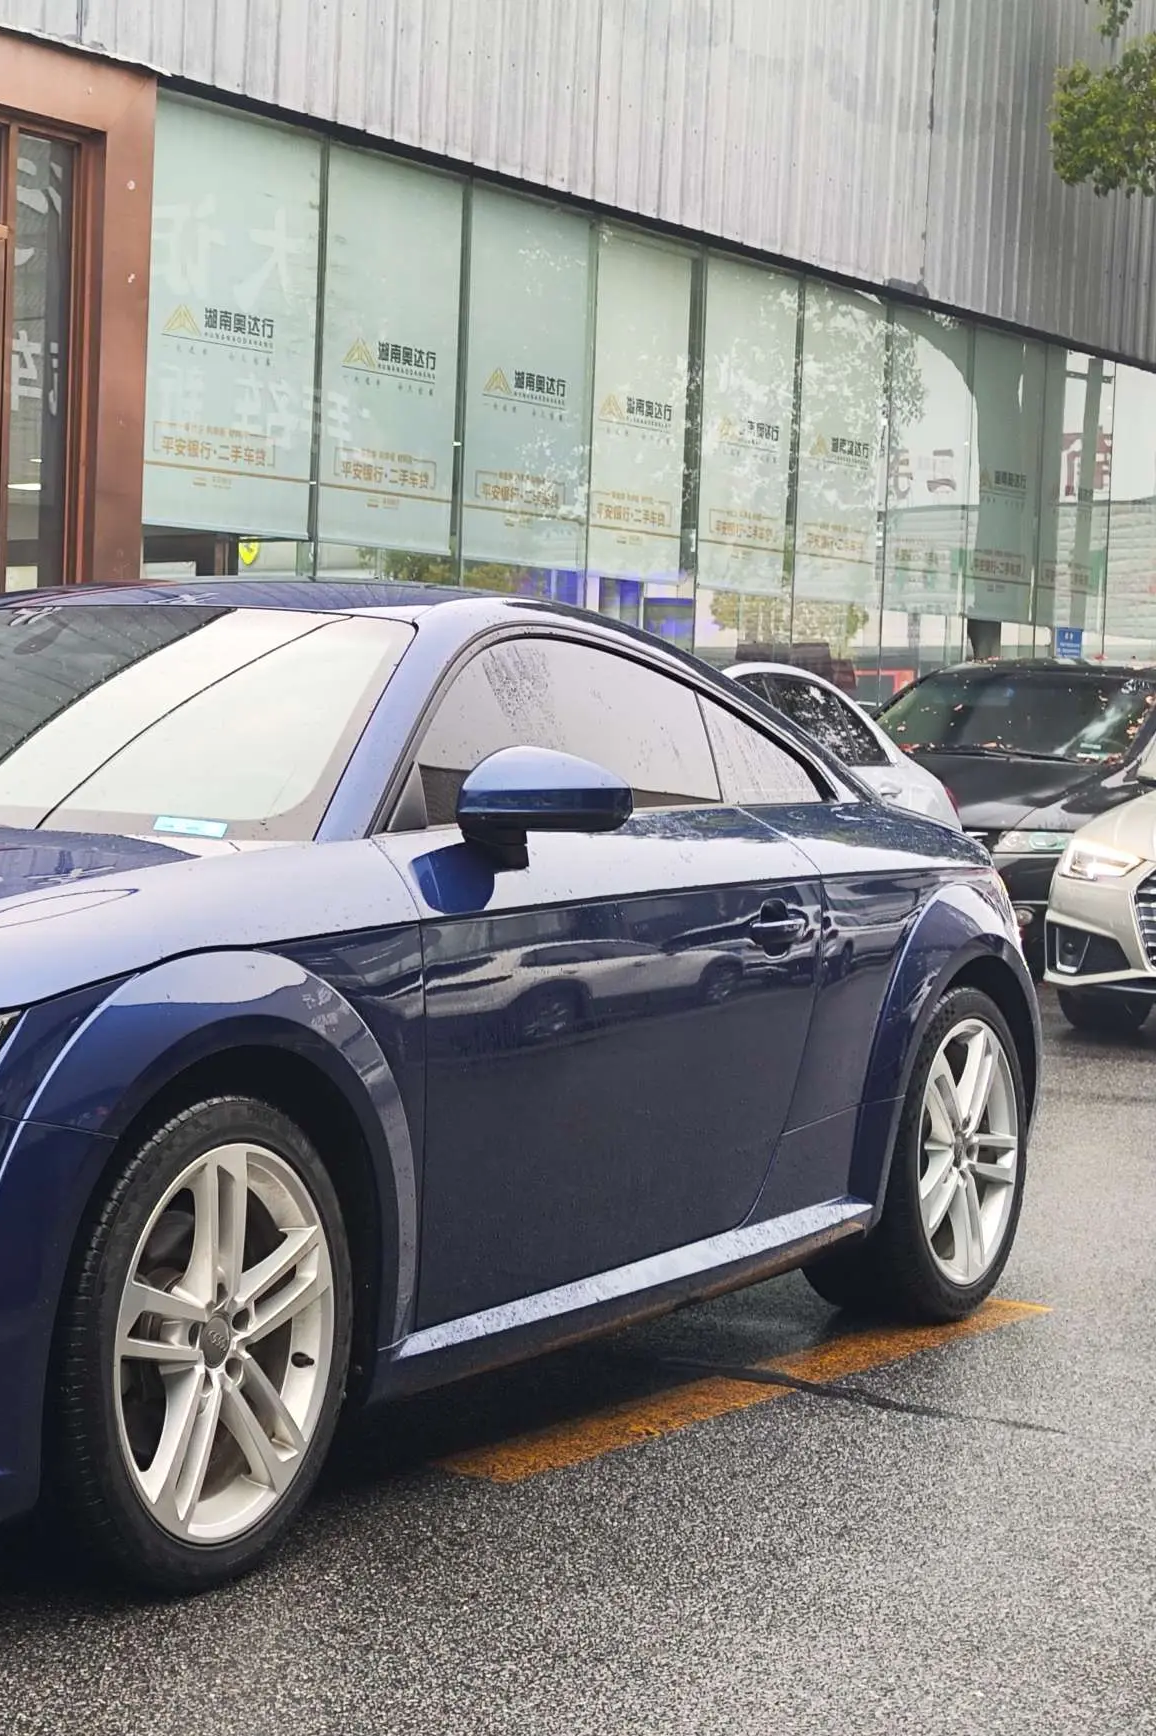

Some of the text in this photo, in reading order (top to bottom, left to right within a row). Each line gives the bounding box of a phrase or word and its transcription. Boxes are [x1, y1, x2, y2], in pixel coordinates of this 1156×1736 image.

[204, 307, 274, 339] 湖南奥达行
[378, 341, 436, 370] 湖南奥达行
[514, 370, 566, 397] 湖南奥达行
